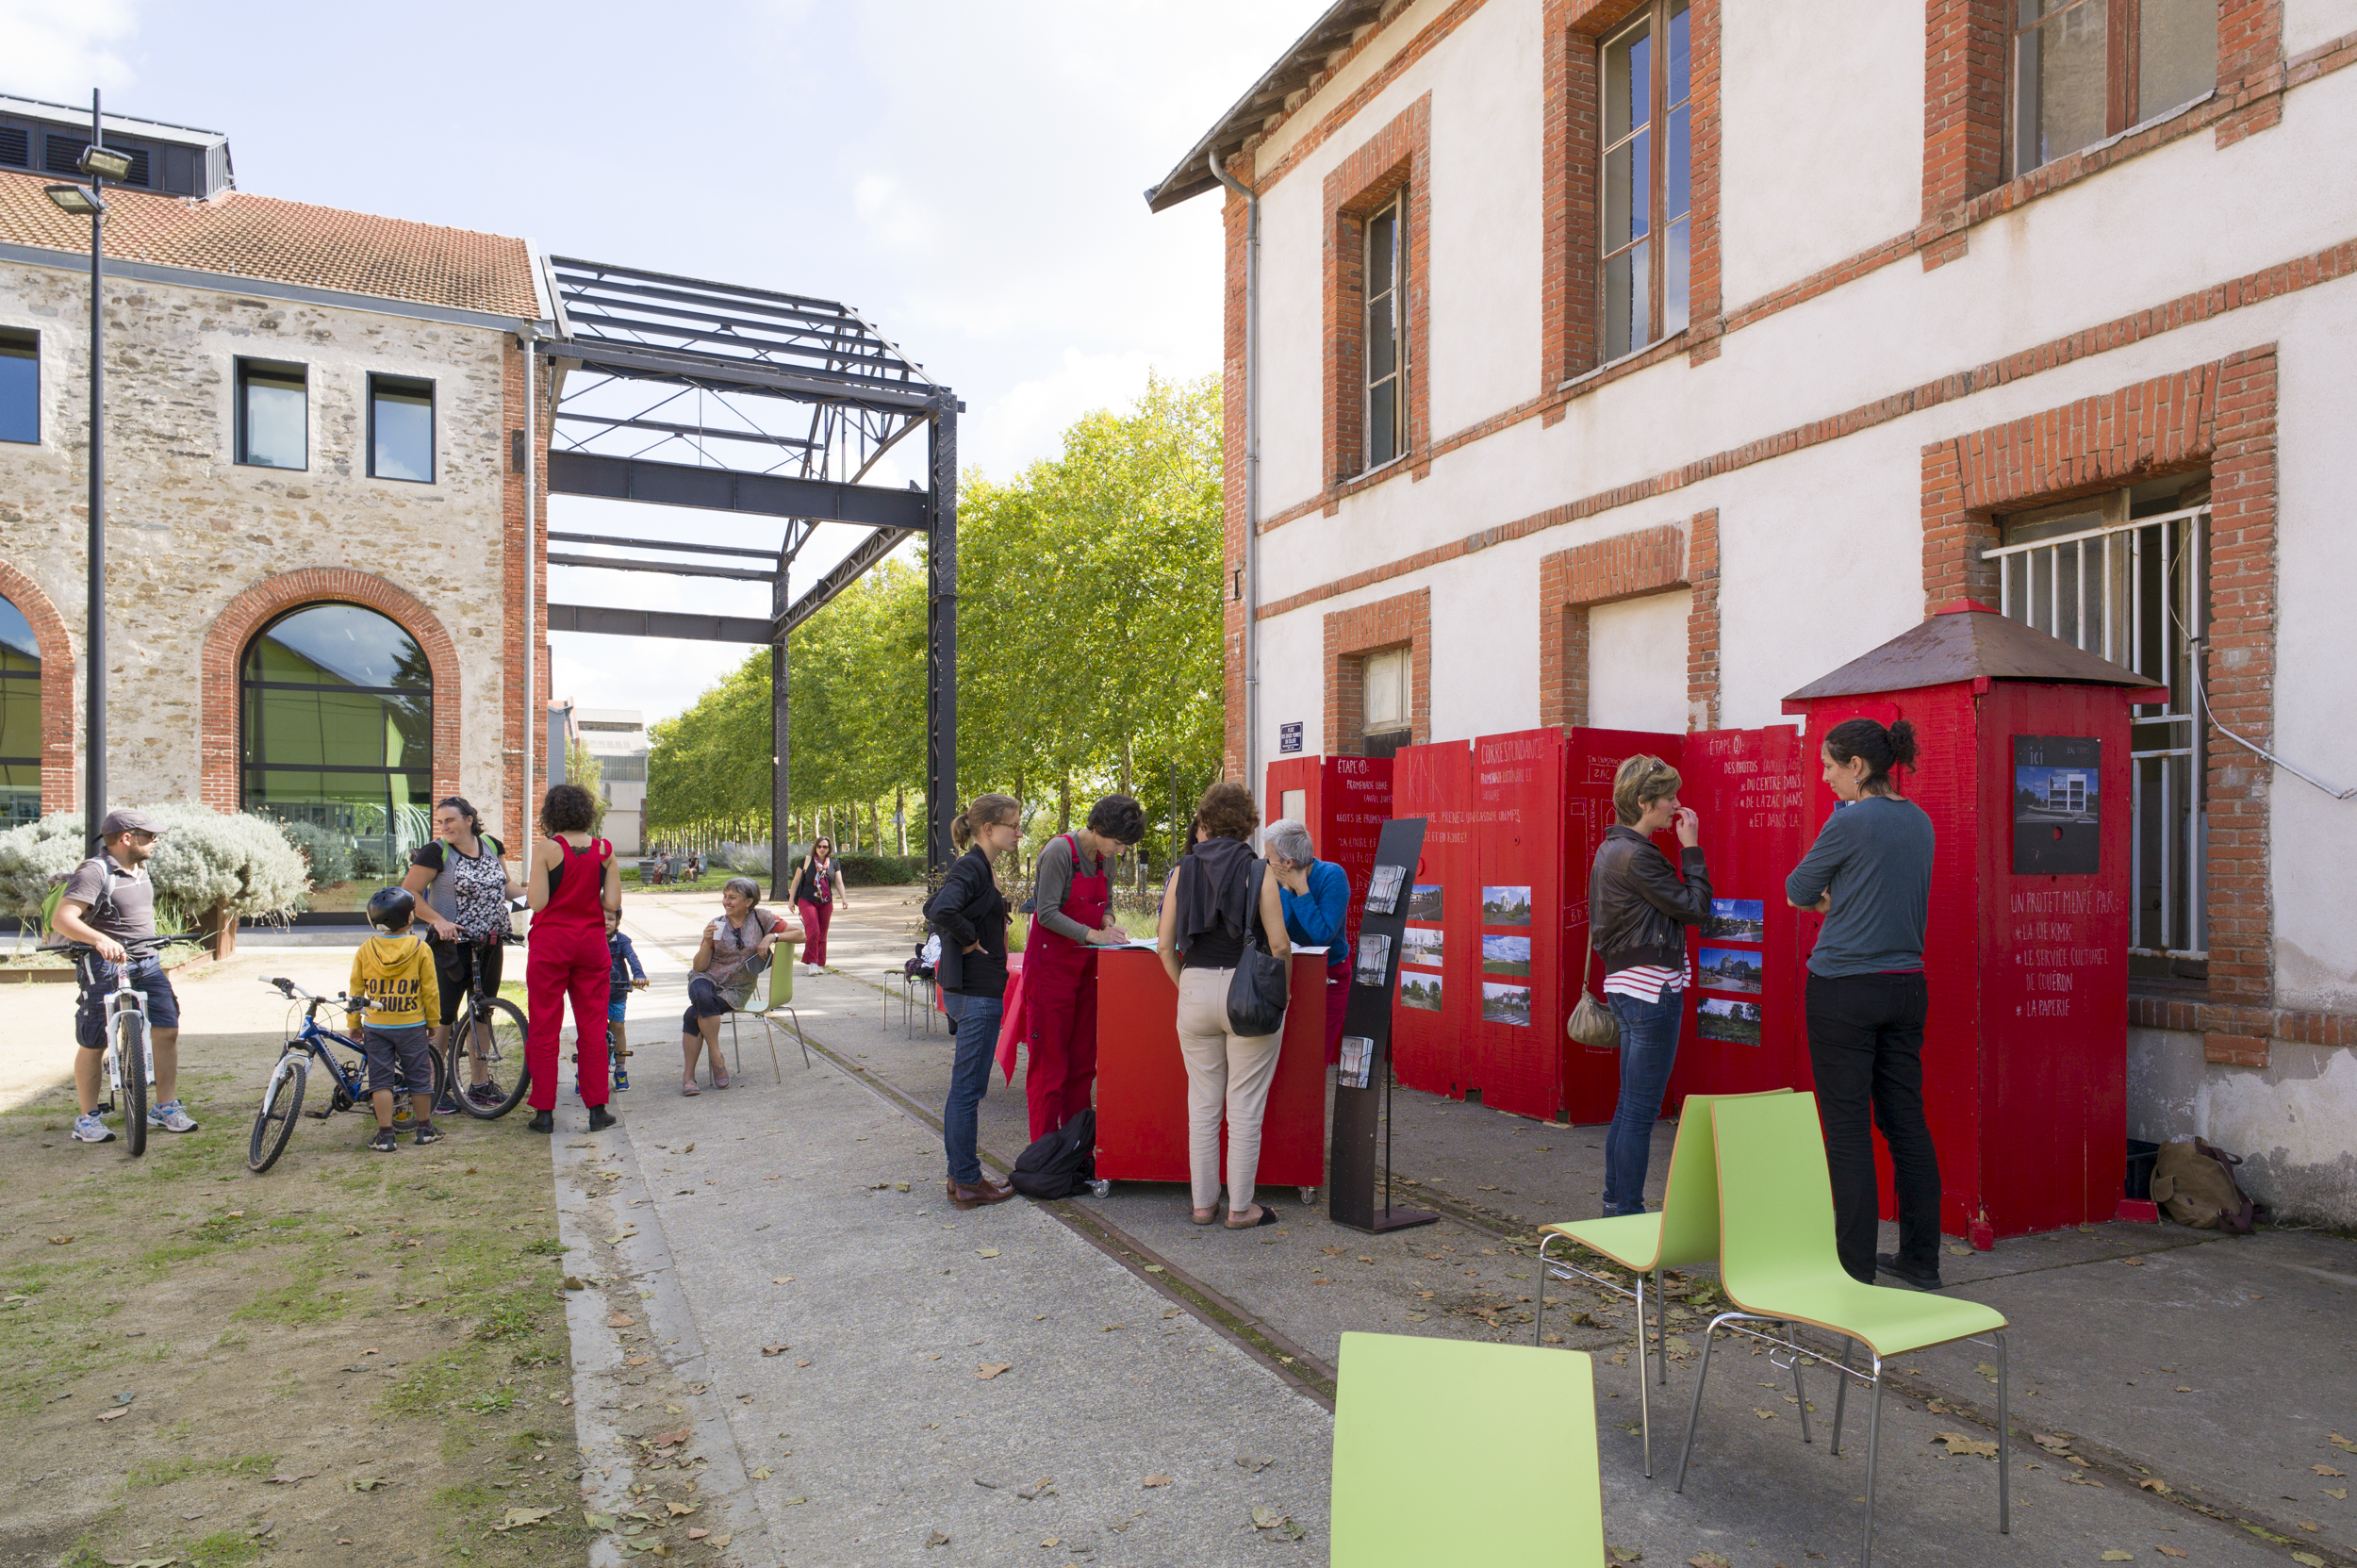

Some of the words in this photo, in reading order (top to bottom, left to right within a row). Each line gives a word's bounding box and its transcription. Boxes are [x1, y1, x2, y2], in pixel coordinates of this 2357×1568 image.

[1709, 738, 1731, 755] ÉTAPE
[2030, 746, 2043, 765] ici
[1338, 758, 1358, 774] ÉTAPE
[1593, 768, 1611, 780] ZAC
[1724, 761, 1735, 774] DES
[1736, 760, 1758, 773] PHOTOS
[1347, 780, 1374, 790] PROMENADE
[1755, 776, 1781, 791] CENTRE
[1783, 774, 1800, 790] DANS
[1746, 796, 1754, 808] DE
[1766, 794, 1780, 808] ZAC
[1783, 792, 1804, 808] DANS
[1768, 814, 1787, 828] DANS
[2011, 892, 2025, 913] UN
[2026, 891, 2060, 914] PROJET
[2063, 883, 2093, 915] MENÉ
[2022, 924, 2033, 940] LA
[2051, 922, 2072, 941] KMK
[2024, 949, 2034, 966] LE
[2036, 946, 2068, 967] SERVICE
[2070, 947, 2109, 966] CULTUREL
[363, 979, 420, 995] FOLLOW
[2026, 973, 2036, 991] DE
[378, 996, 419, 1013] RULES
[2027, 999, 2036, 1017] LA
[2038, 996, 2071, 1017] PAPERIE
